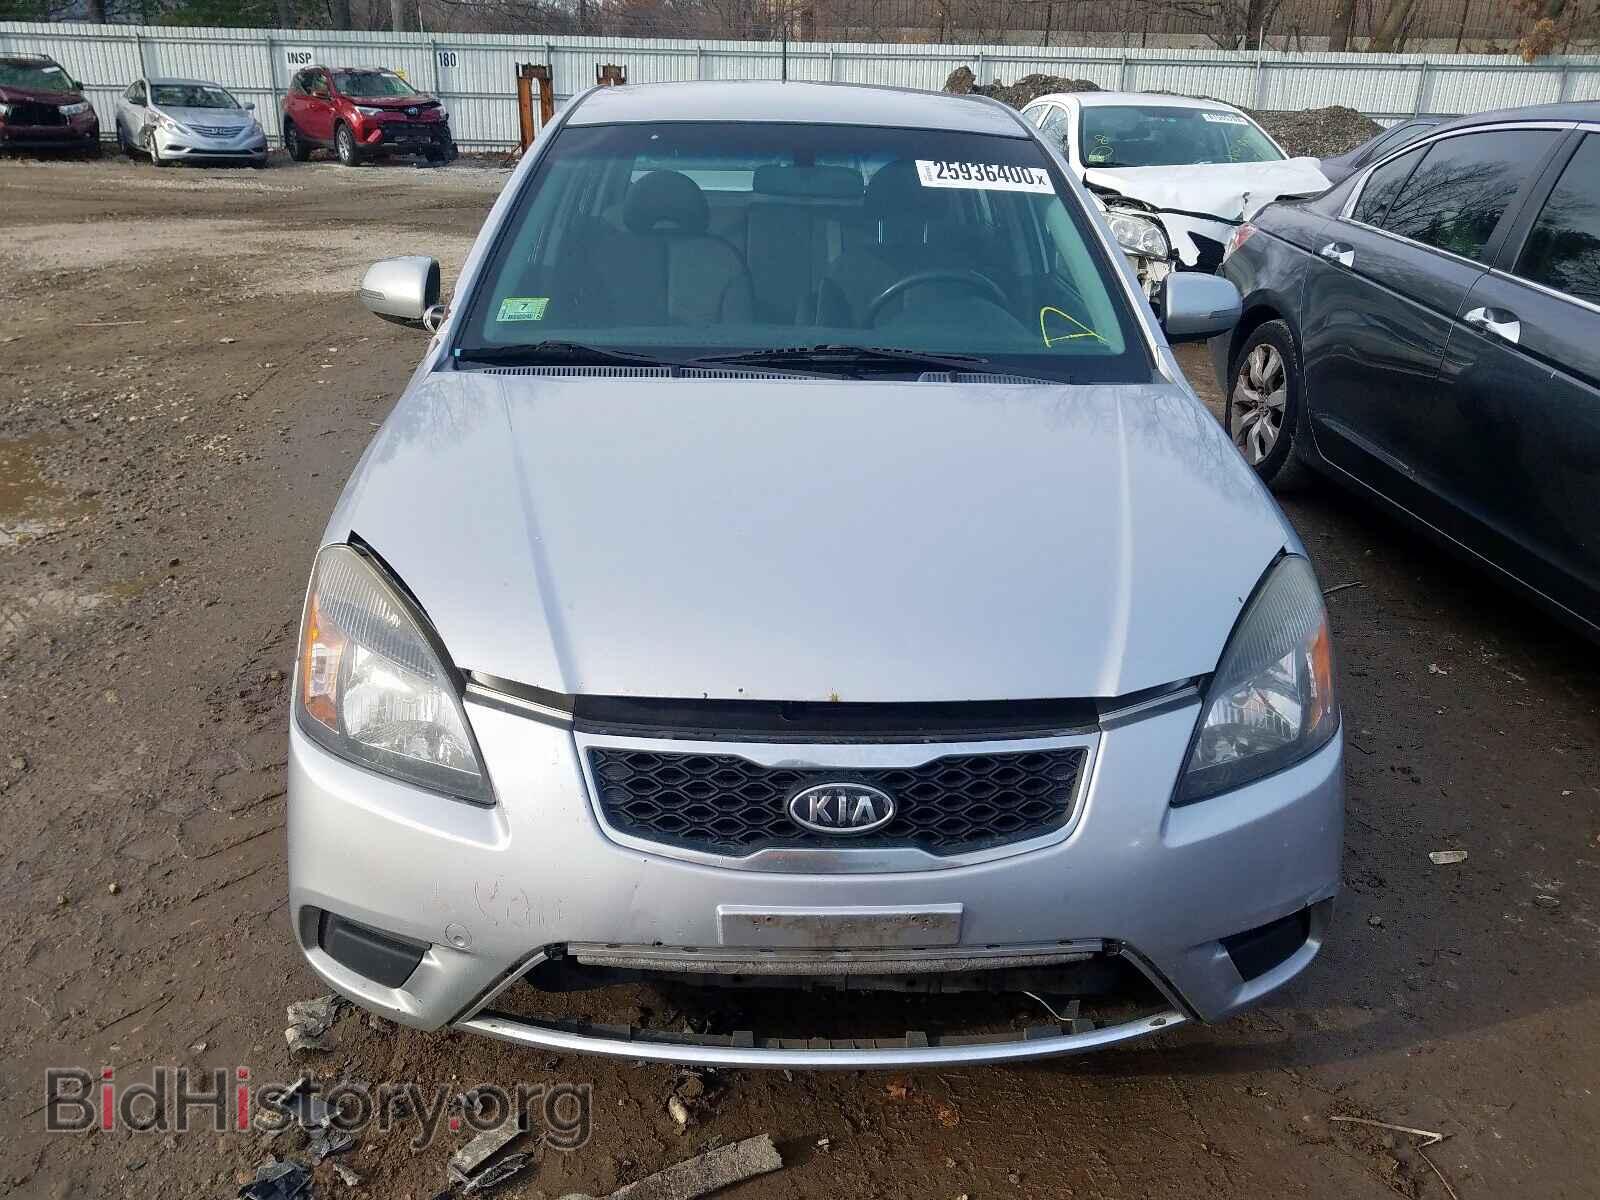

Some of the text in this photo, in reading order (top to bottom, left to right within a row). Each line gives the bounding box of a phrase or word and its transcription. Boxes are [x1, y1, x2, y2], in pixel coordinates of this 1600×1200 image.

[287, 52, 312, 64] INSP
[438, 52, 457, 67] 180
[934, 161, 1034, 184] 25936400
[808, 795, 877, 822] KIA
